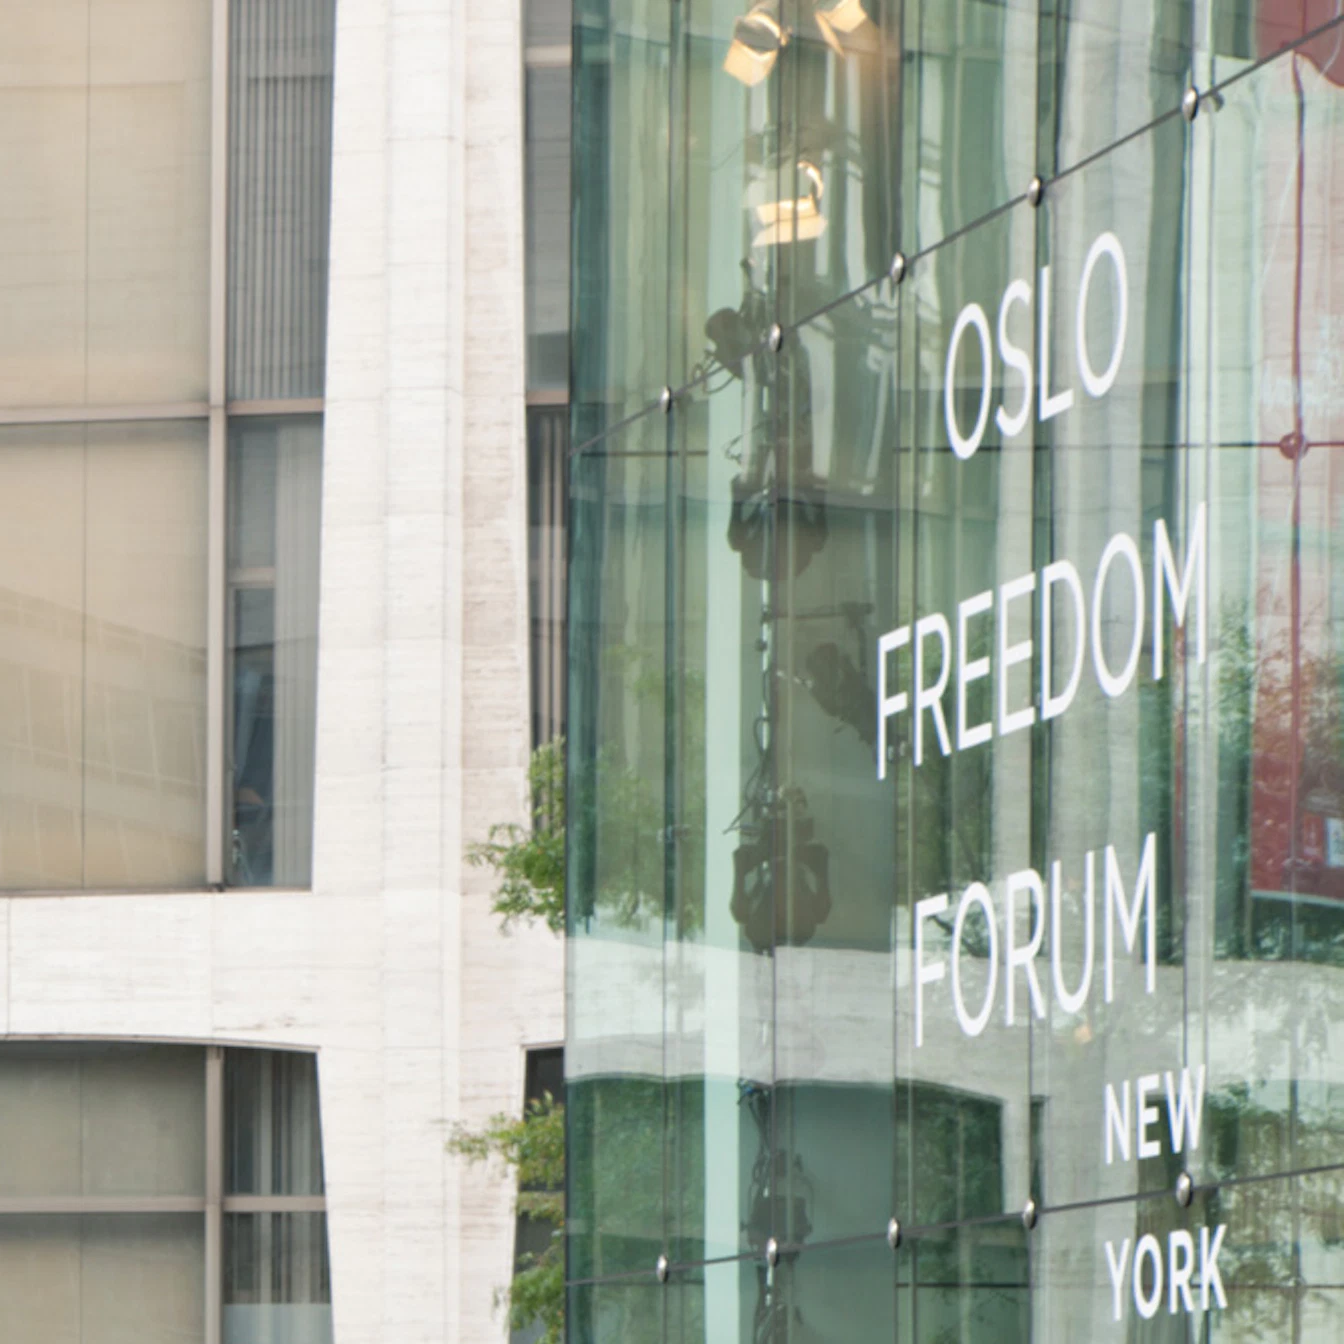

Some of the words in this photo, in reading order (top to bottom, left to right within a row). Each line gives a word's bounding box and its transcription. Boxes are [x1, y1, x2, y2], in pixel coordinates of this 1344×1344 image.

[945, 232, 1128, 459] OSLO
[877, 501, 1205, 779] FREEDOM
[915, 832, 1156, 1046] FORUM
[1105, 1065, 1206, 1164] NEW
[1106, 1224, 1227, 1321] YORK
